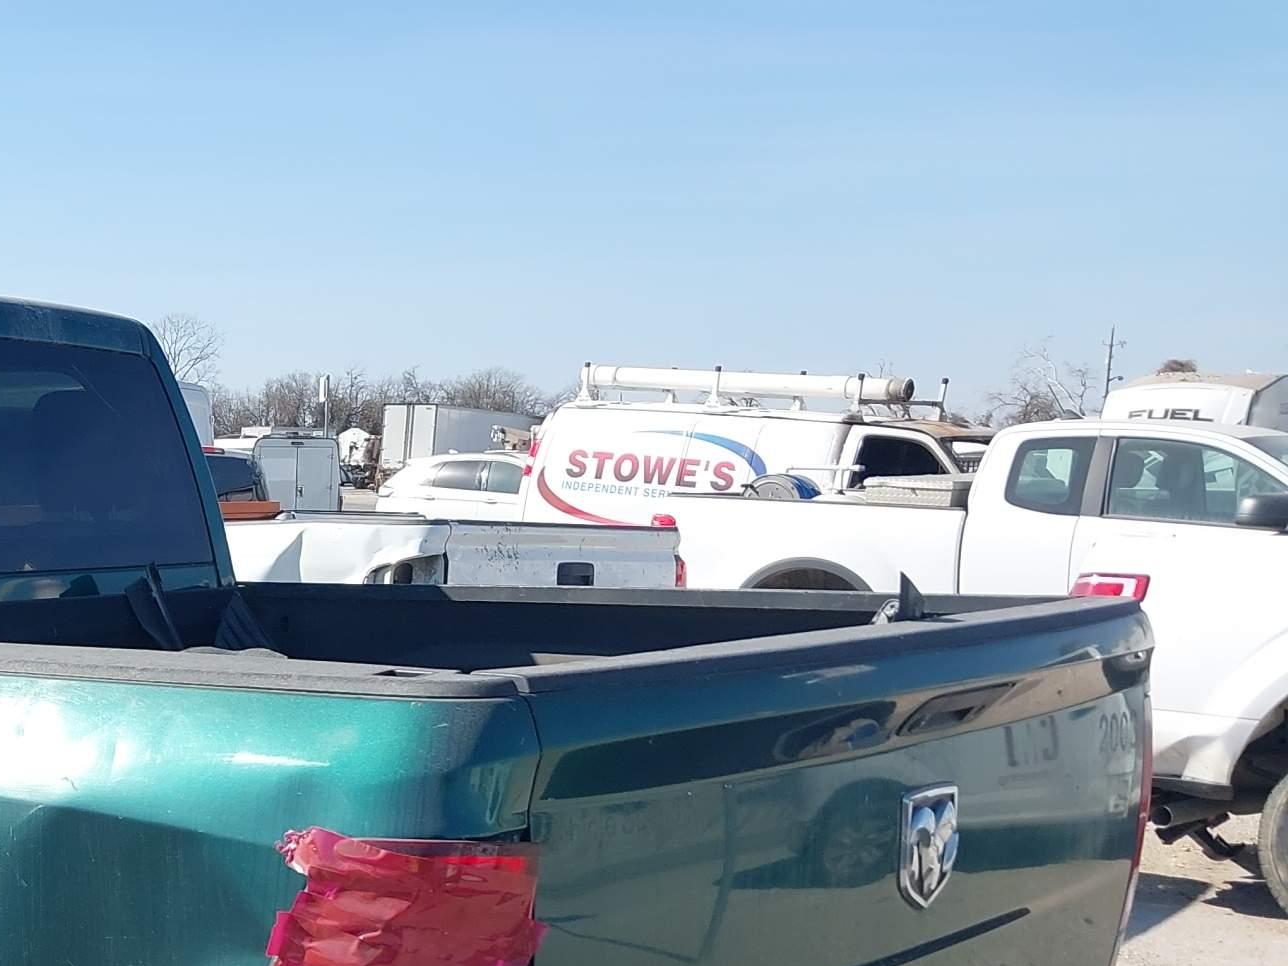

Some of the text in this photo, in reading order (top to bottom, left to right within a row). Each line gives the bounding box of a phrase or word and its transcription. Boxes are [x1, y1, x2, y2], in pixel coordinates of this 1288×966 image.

[1128, 408, 1214, 422] FUEL
[566, 449, 736, 491] STOWE'S
[561, 479, 640, 497] INDEPENDENT
